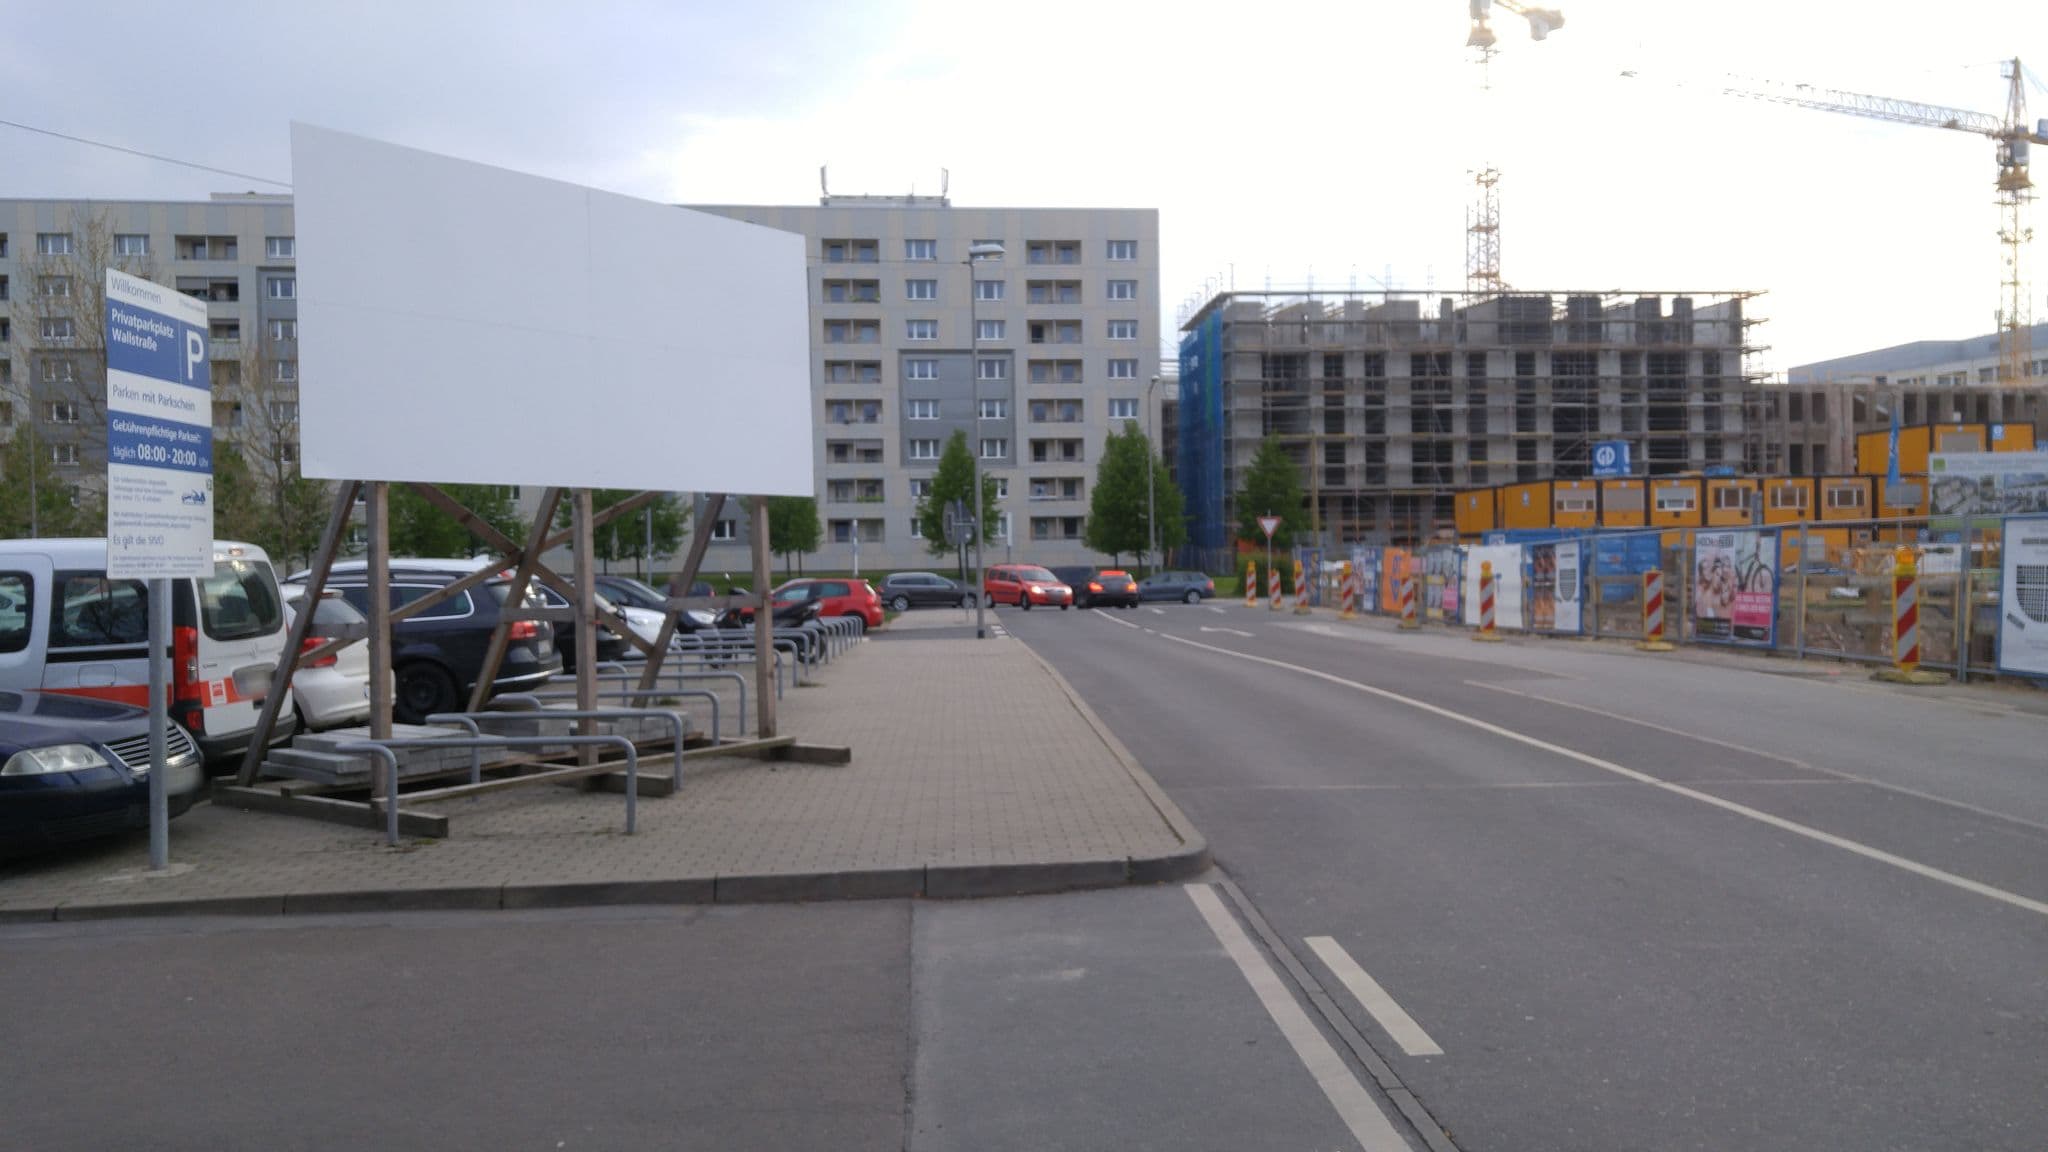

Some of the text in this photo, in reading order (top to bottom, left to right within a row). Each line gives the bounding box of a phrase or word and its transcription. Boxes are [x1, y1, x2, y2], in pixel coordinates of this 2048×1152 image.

[111, 276, 161, 304] Willkommen
[111, 308, 175, 338] Privatparkplatz
[112, 328, 158, 351] Wallstraße
[186, 329, 204, 380] P
[112, 384, 196, 411] Parken mit Parkschein
[112, 419, 177, 440] Gebührenpflichtige
[113, 447, 136, 460] täglich
[137, 443, 166, 462] 08:00
[172, 449, 197, 466] 20:00
[199, 457, 209, 467] Uhr
[113, 535, 121, 545] Es
[122, 535, 134, 547] gilt
